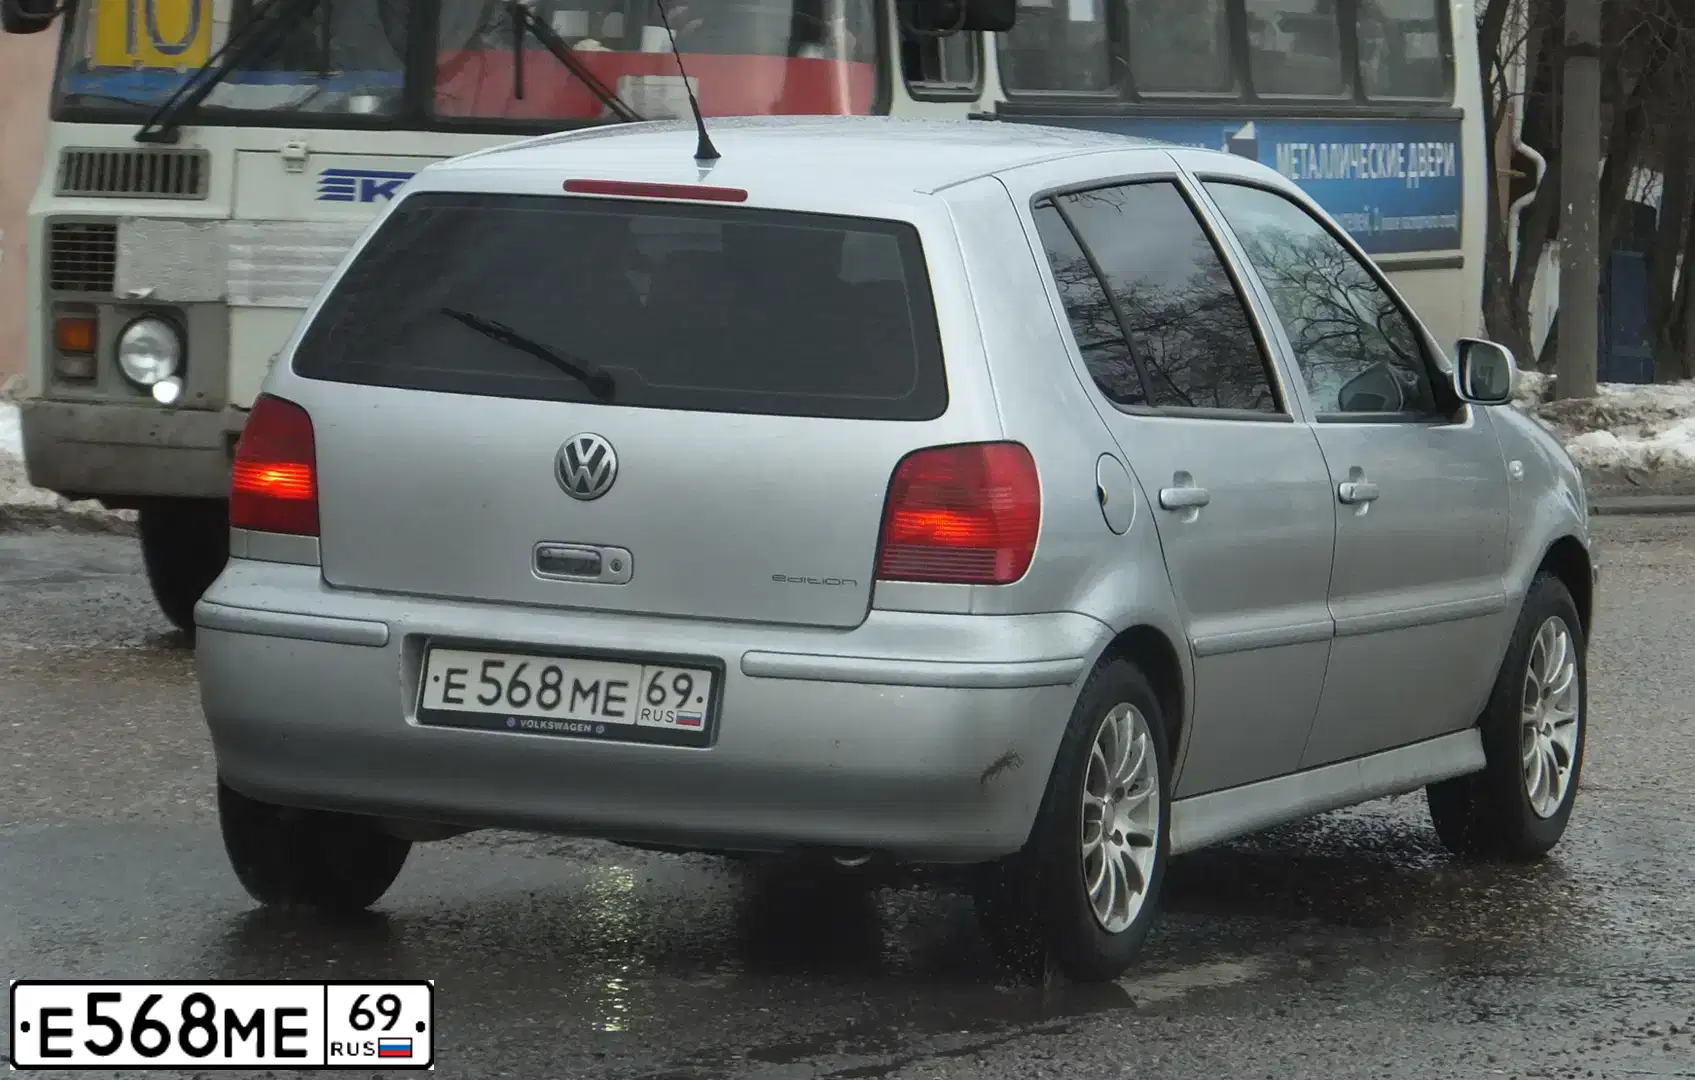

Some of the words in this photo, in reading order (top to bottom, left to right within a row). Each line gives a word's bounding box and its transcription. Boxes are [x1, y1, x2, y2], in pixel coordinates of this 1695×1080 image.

[1276, 142, 1405, 180] МЕТАЛЛИЧЕСКИЕ
[1407, 142, 1456, 188] ДВЕРИ
[772, 574, 858, 586] edition
[646, 670, 694, 708] 69
[640, 708, 674, 723] RUS
[520, 719, 592, 732] VOLKSWAGEN
